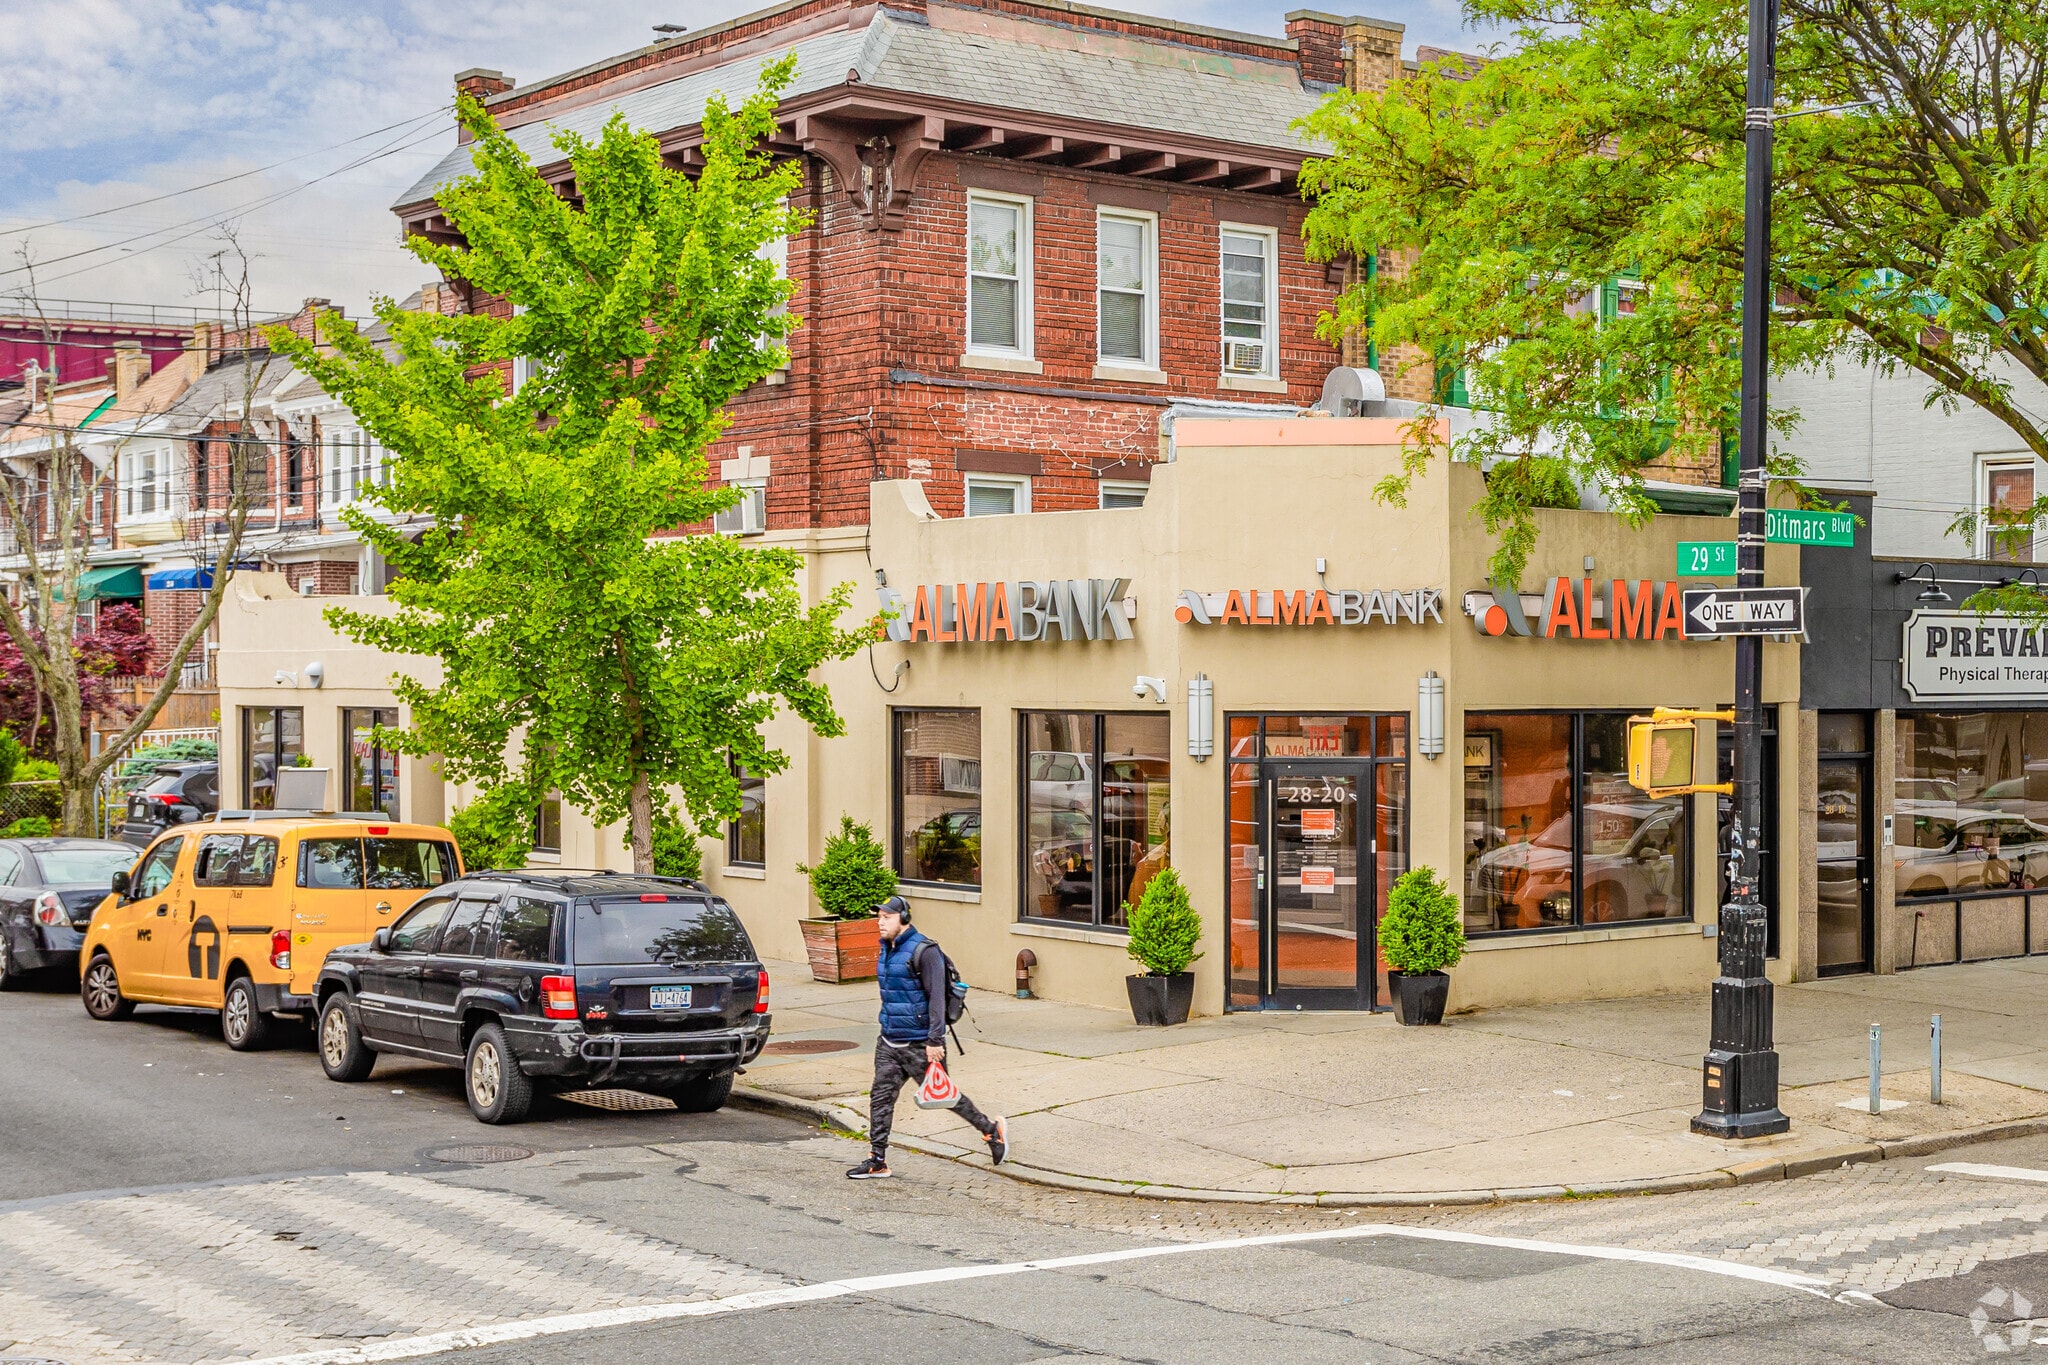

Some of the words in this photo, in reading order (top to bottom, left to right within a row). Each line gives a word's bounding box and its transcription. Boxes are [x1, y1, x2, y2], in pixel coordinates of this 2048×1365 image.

[1767, 512, 1826, 541] Ditmars
[1831, 517, 1851, 534] Blvd
[1691, 547, 1709, 571] 29
[1715, 546, 1725, 562] St
[1702, 604, 1734, 621] ONE
[1750, 602, 1786, 619] WAY
[1939, 666, 1999, 685] Physical
[1287, 786, 1345, 803] 28-20
[137, 928, 152, 941] NYC
